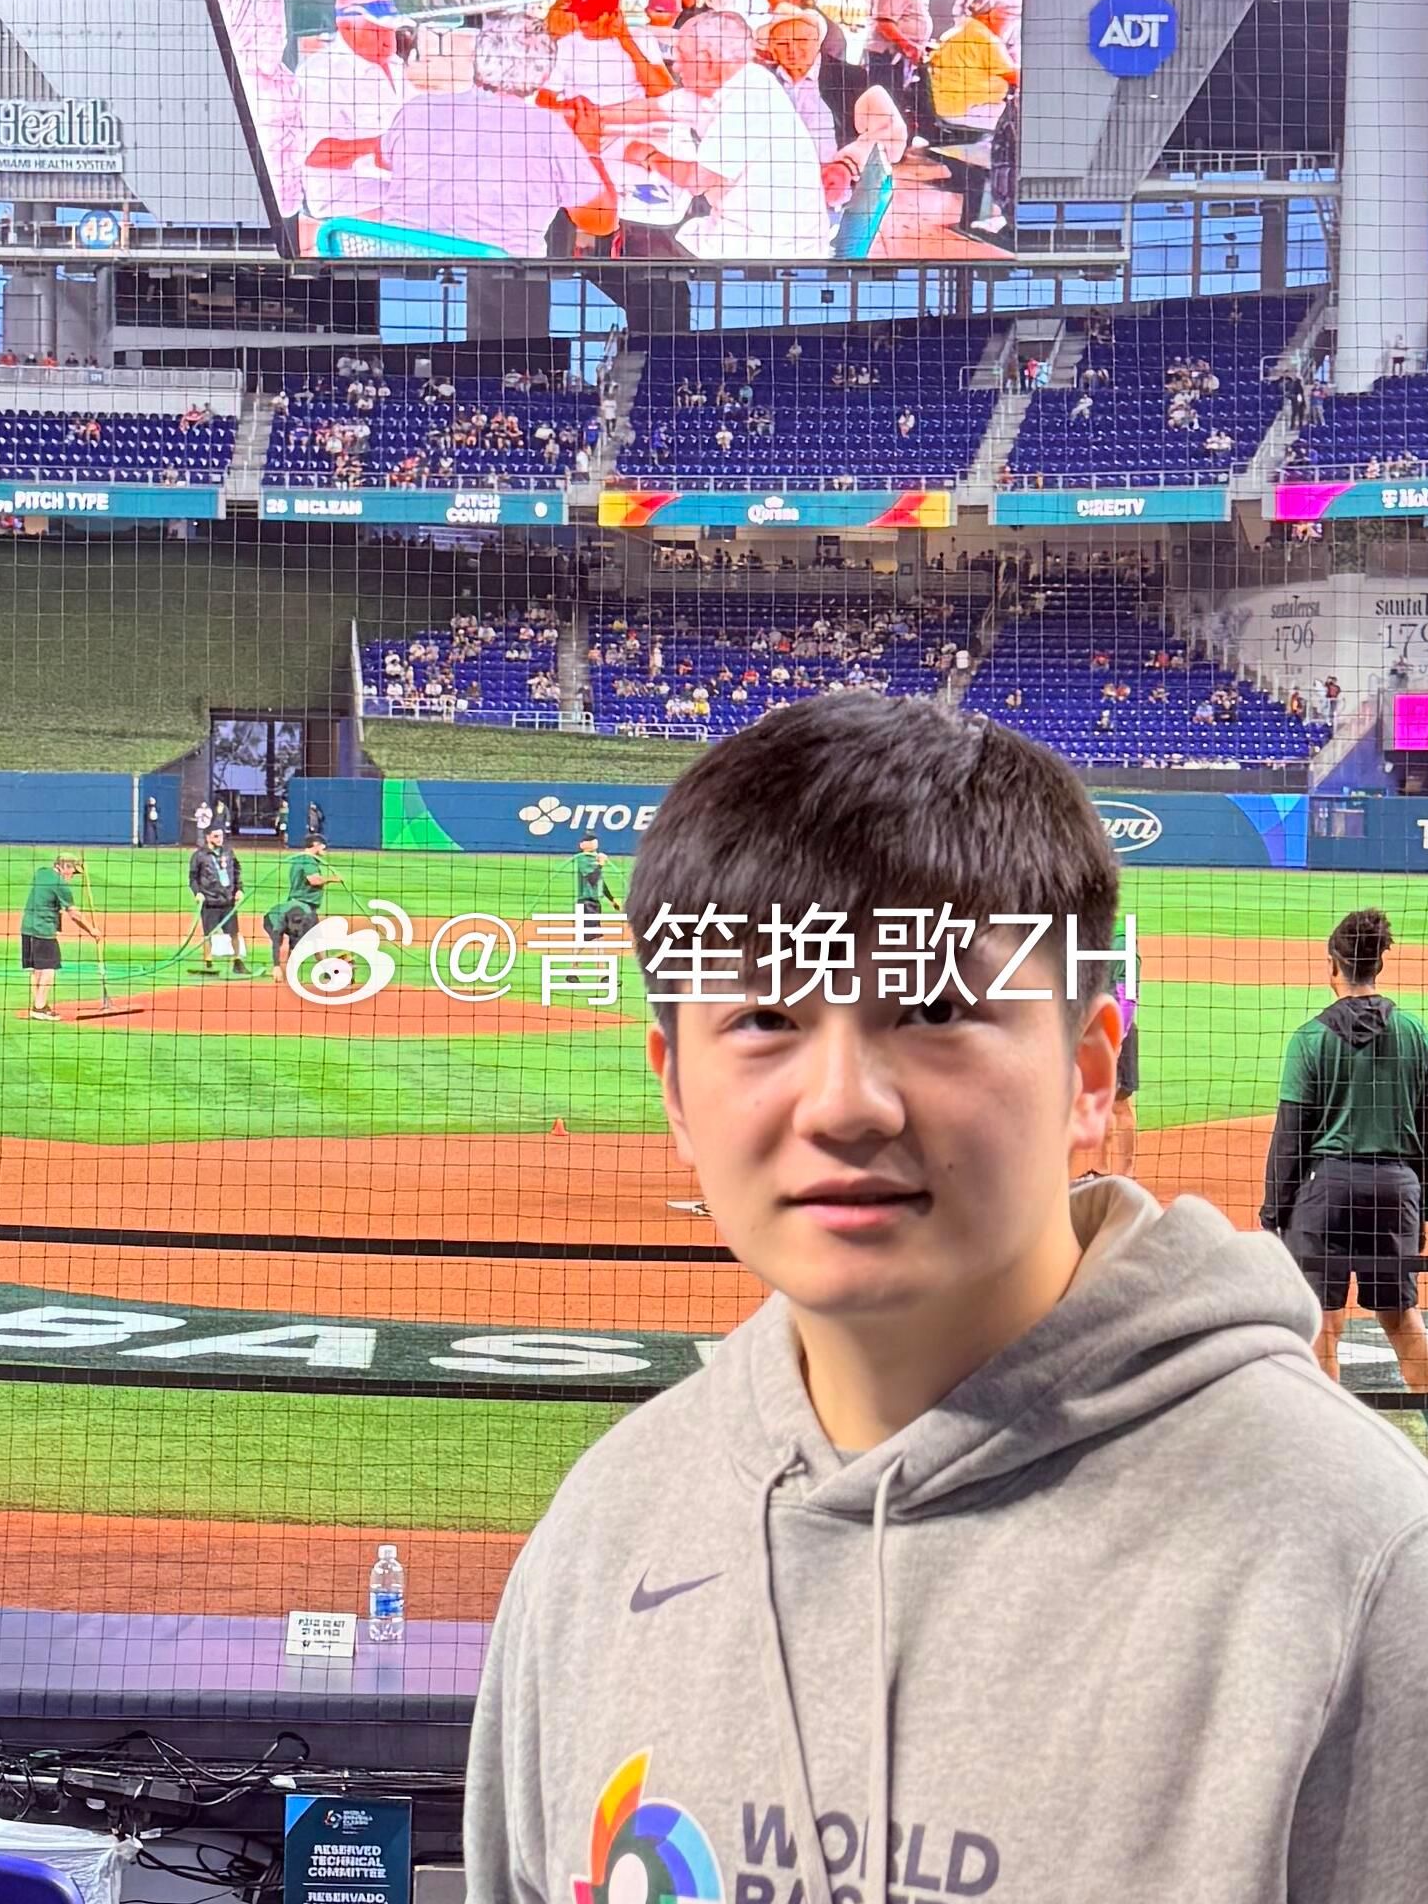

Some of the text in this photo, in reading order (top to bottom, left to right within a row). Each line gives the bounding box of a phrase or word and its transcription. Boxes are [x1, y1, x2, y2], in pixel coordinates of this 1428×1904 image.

[1099, 14, 1170, 50] ADT
[34, 158, 73, 169] HEALTH
[75, 158, 117, 170] SYSTEM
[14, 491, 64, 510] PITCH
[65, 492, 109, 511] TYPE
[1076, 497, 1146, 517] DIRECTV
[1274, 620, 1314, 660] 1796
[313, 1844, 382, 1856] RESERVED
[310, 1855, 384, 1867] TECHNICAL
[307, 1866, 387, 1878] COMMITTEE
[307, 1891, 386, 1903] RESERVADO
